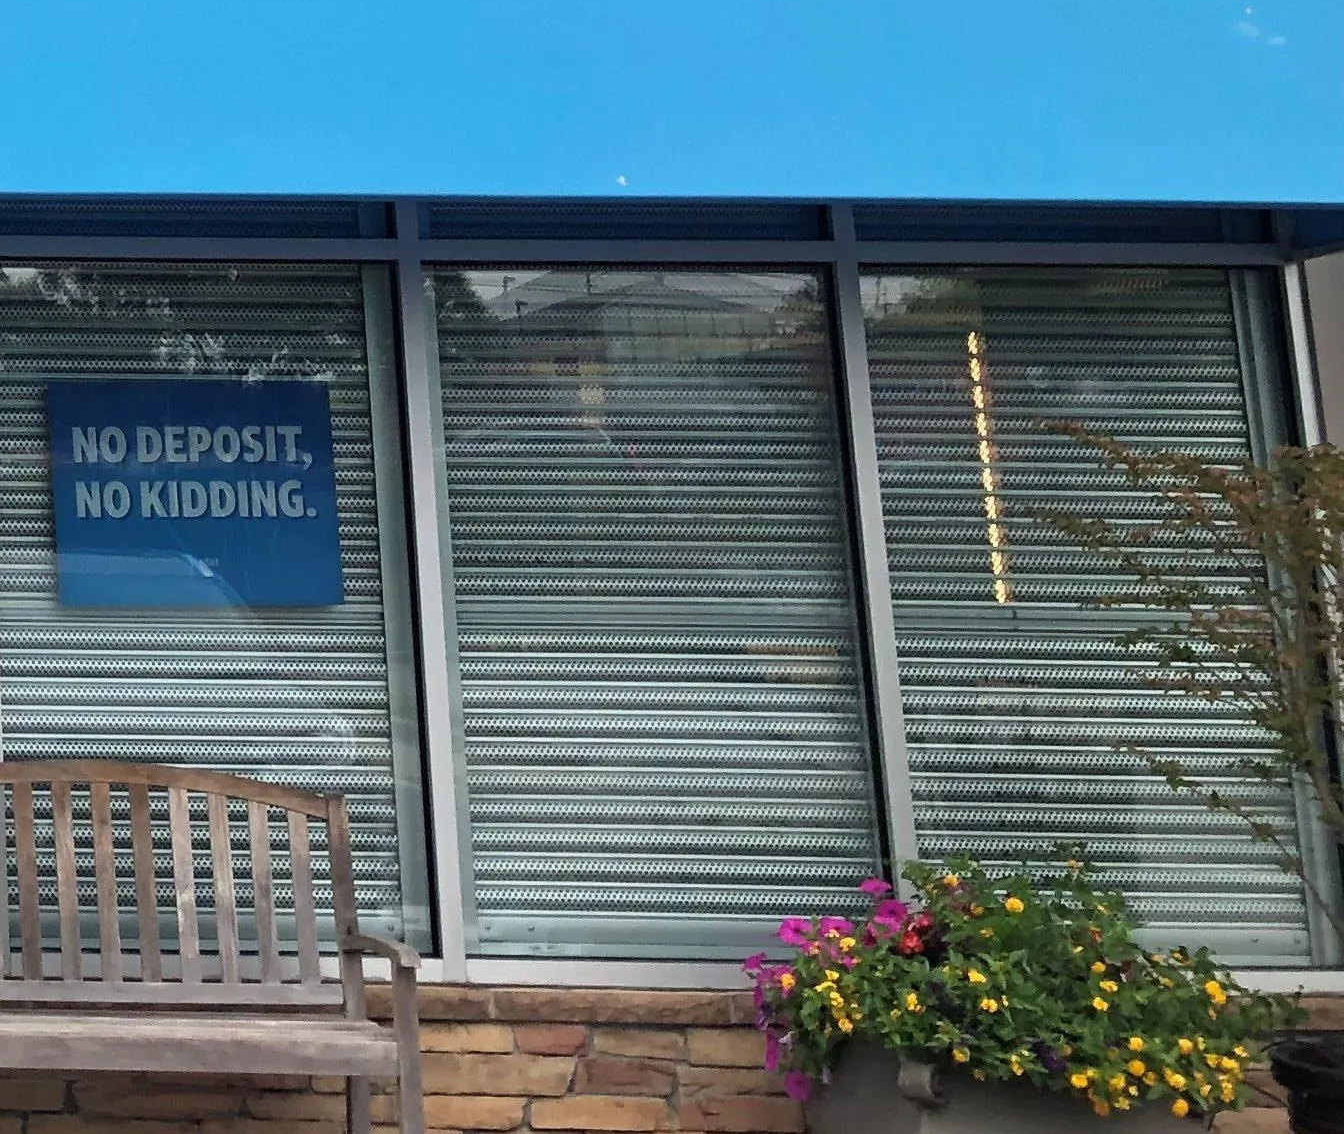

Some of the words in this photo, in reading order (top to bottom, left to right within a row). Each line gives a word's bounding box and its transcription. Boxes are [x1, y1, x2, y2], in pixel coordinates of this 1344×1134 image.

[71, 426, 127, 464] NO
[136, 425, 313, 471] DEPOSIT,
[75, 481, 131, 518] NO
[139, 480, 317, 518] KIDDING.
